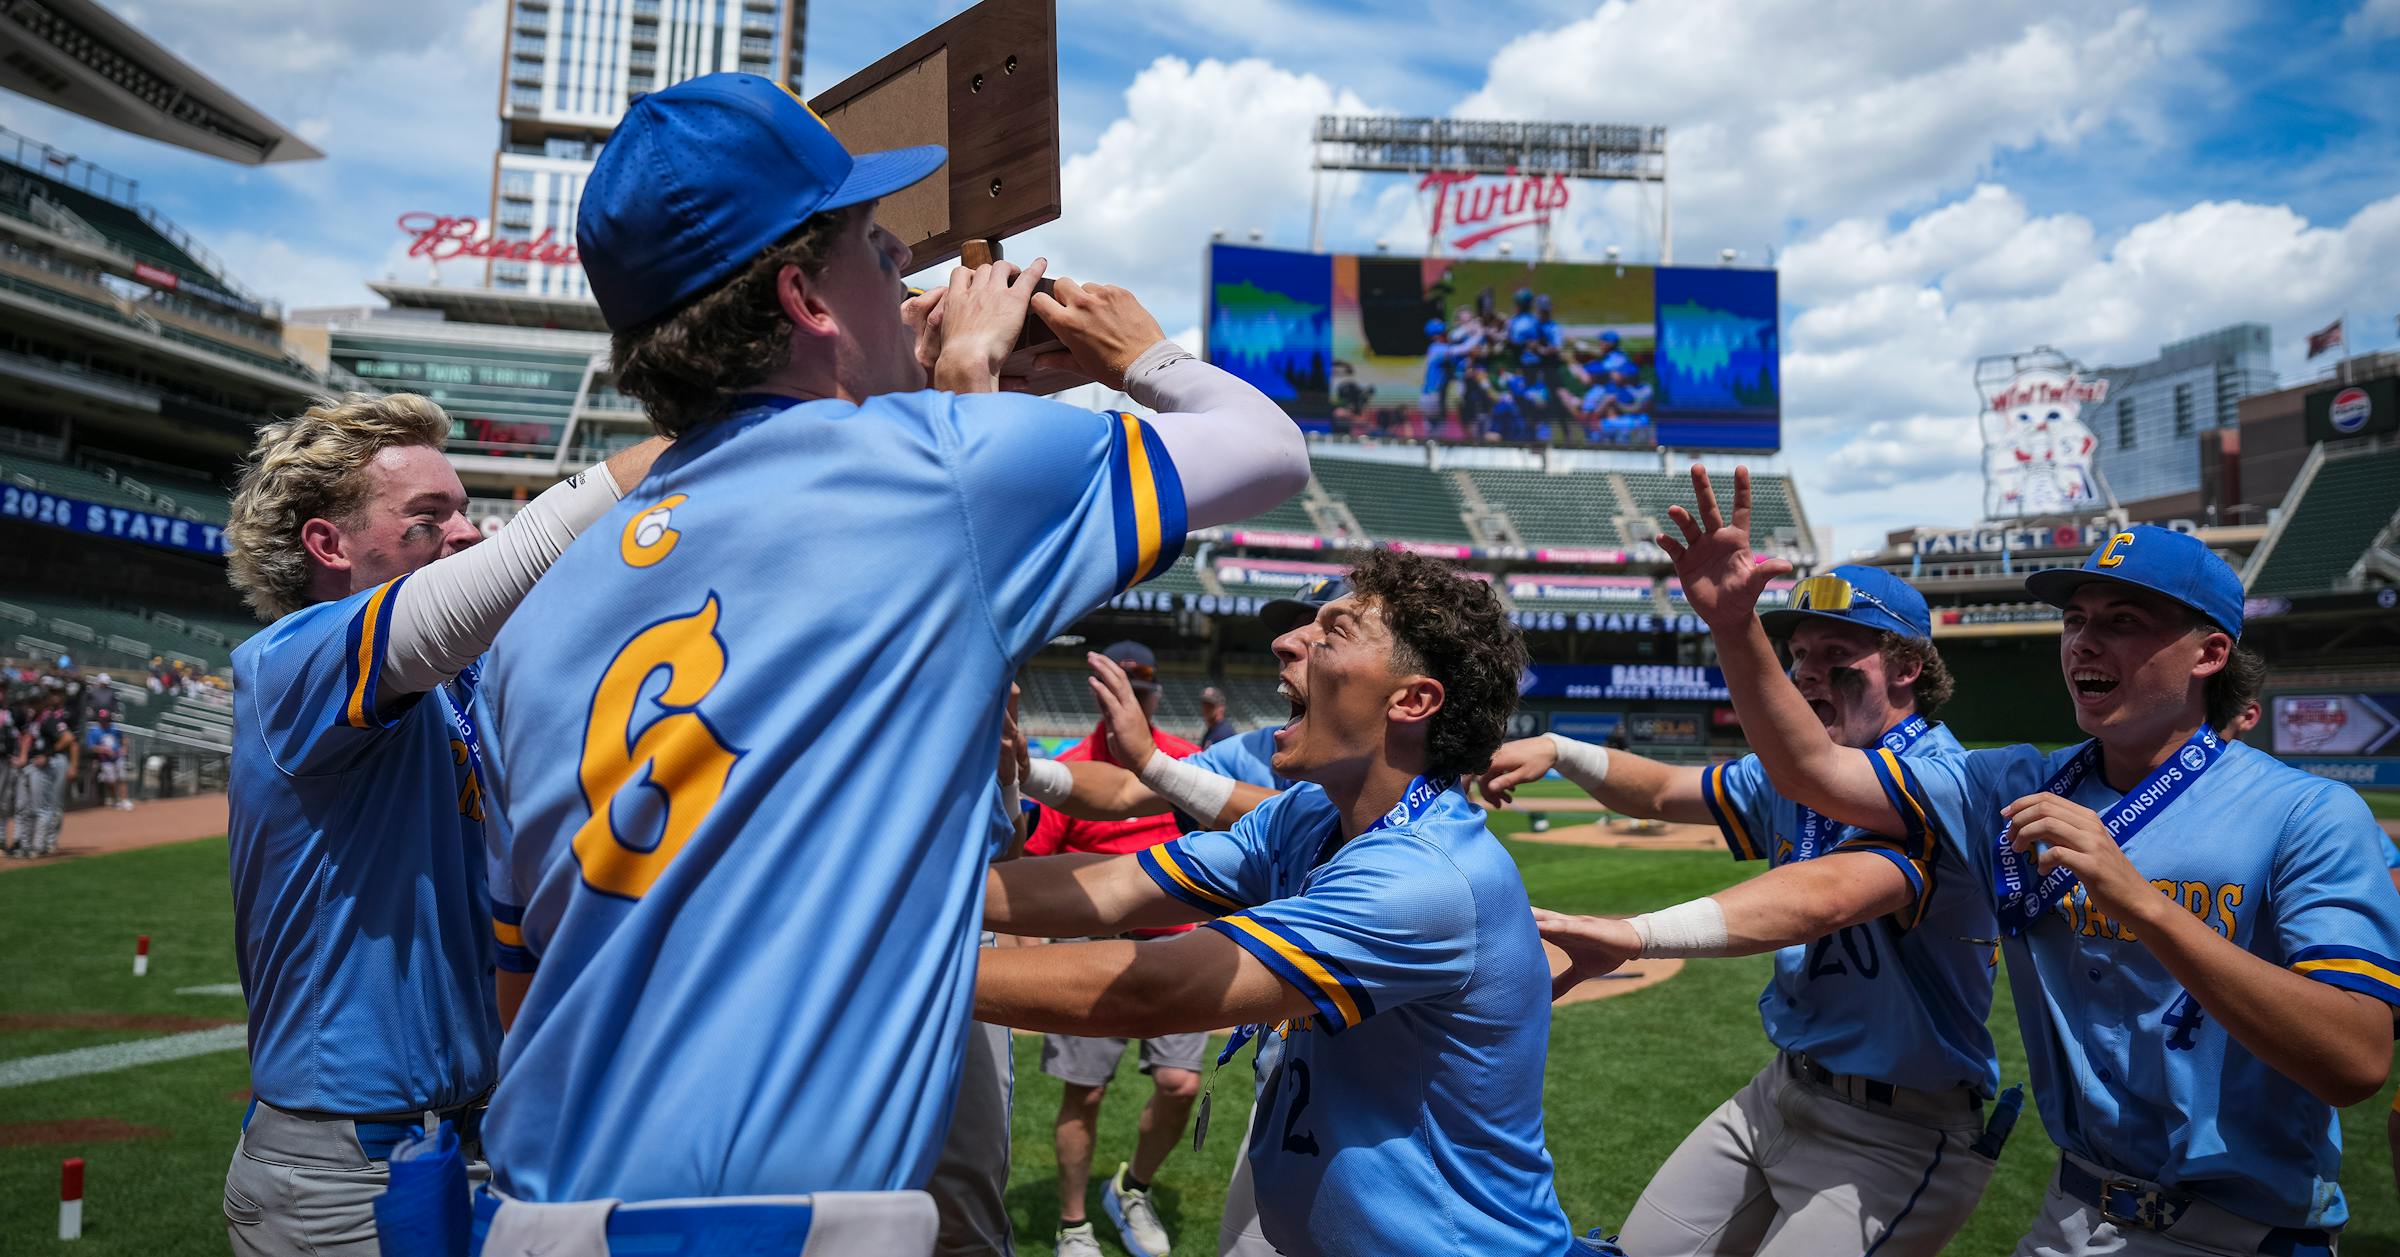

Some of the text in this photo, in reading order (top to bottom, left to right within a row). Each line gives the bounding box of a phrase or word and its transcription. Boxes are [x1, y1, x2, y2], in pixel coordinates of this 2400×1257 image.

[1418, 165, 1570, 240] Twins
[424, 362, 473, 385] TWINS
[2, 487, 73, 527] 2026
[86, 504, 190, 546] STATE
[1914, 525, 2049, 555] TARGET
[2097, 532, 2135, 569] C
[1507, 611, 1569, 632] 2026
[1576, 612, 1654, 634] STATE
[1611, 664, 1710, 687] BASEBALL
[570, 588, 752, 900] 6
[1409, 778, 1449, 809] STATE
[2105, 766, 2183, 839] PIONSHIPS
[1808, 923, 1880, 981] 20
[2160, 988, 2204, 1051] 4
